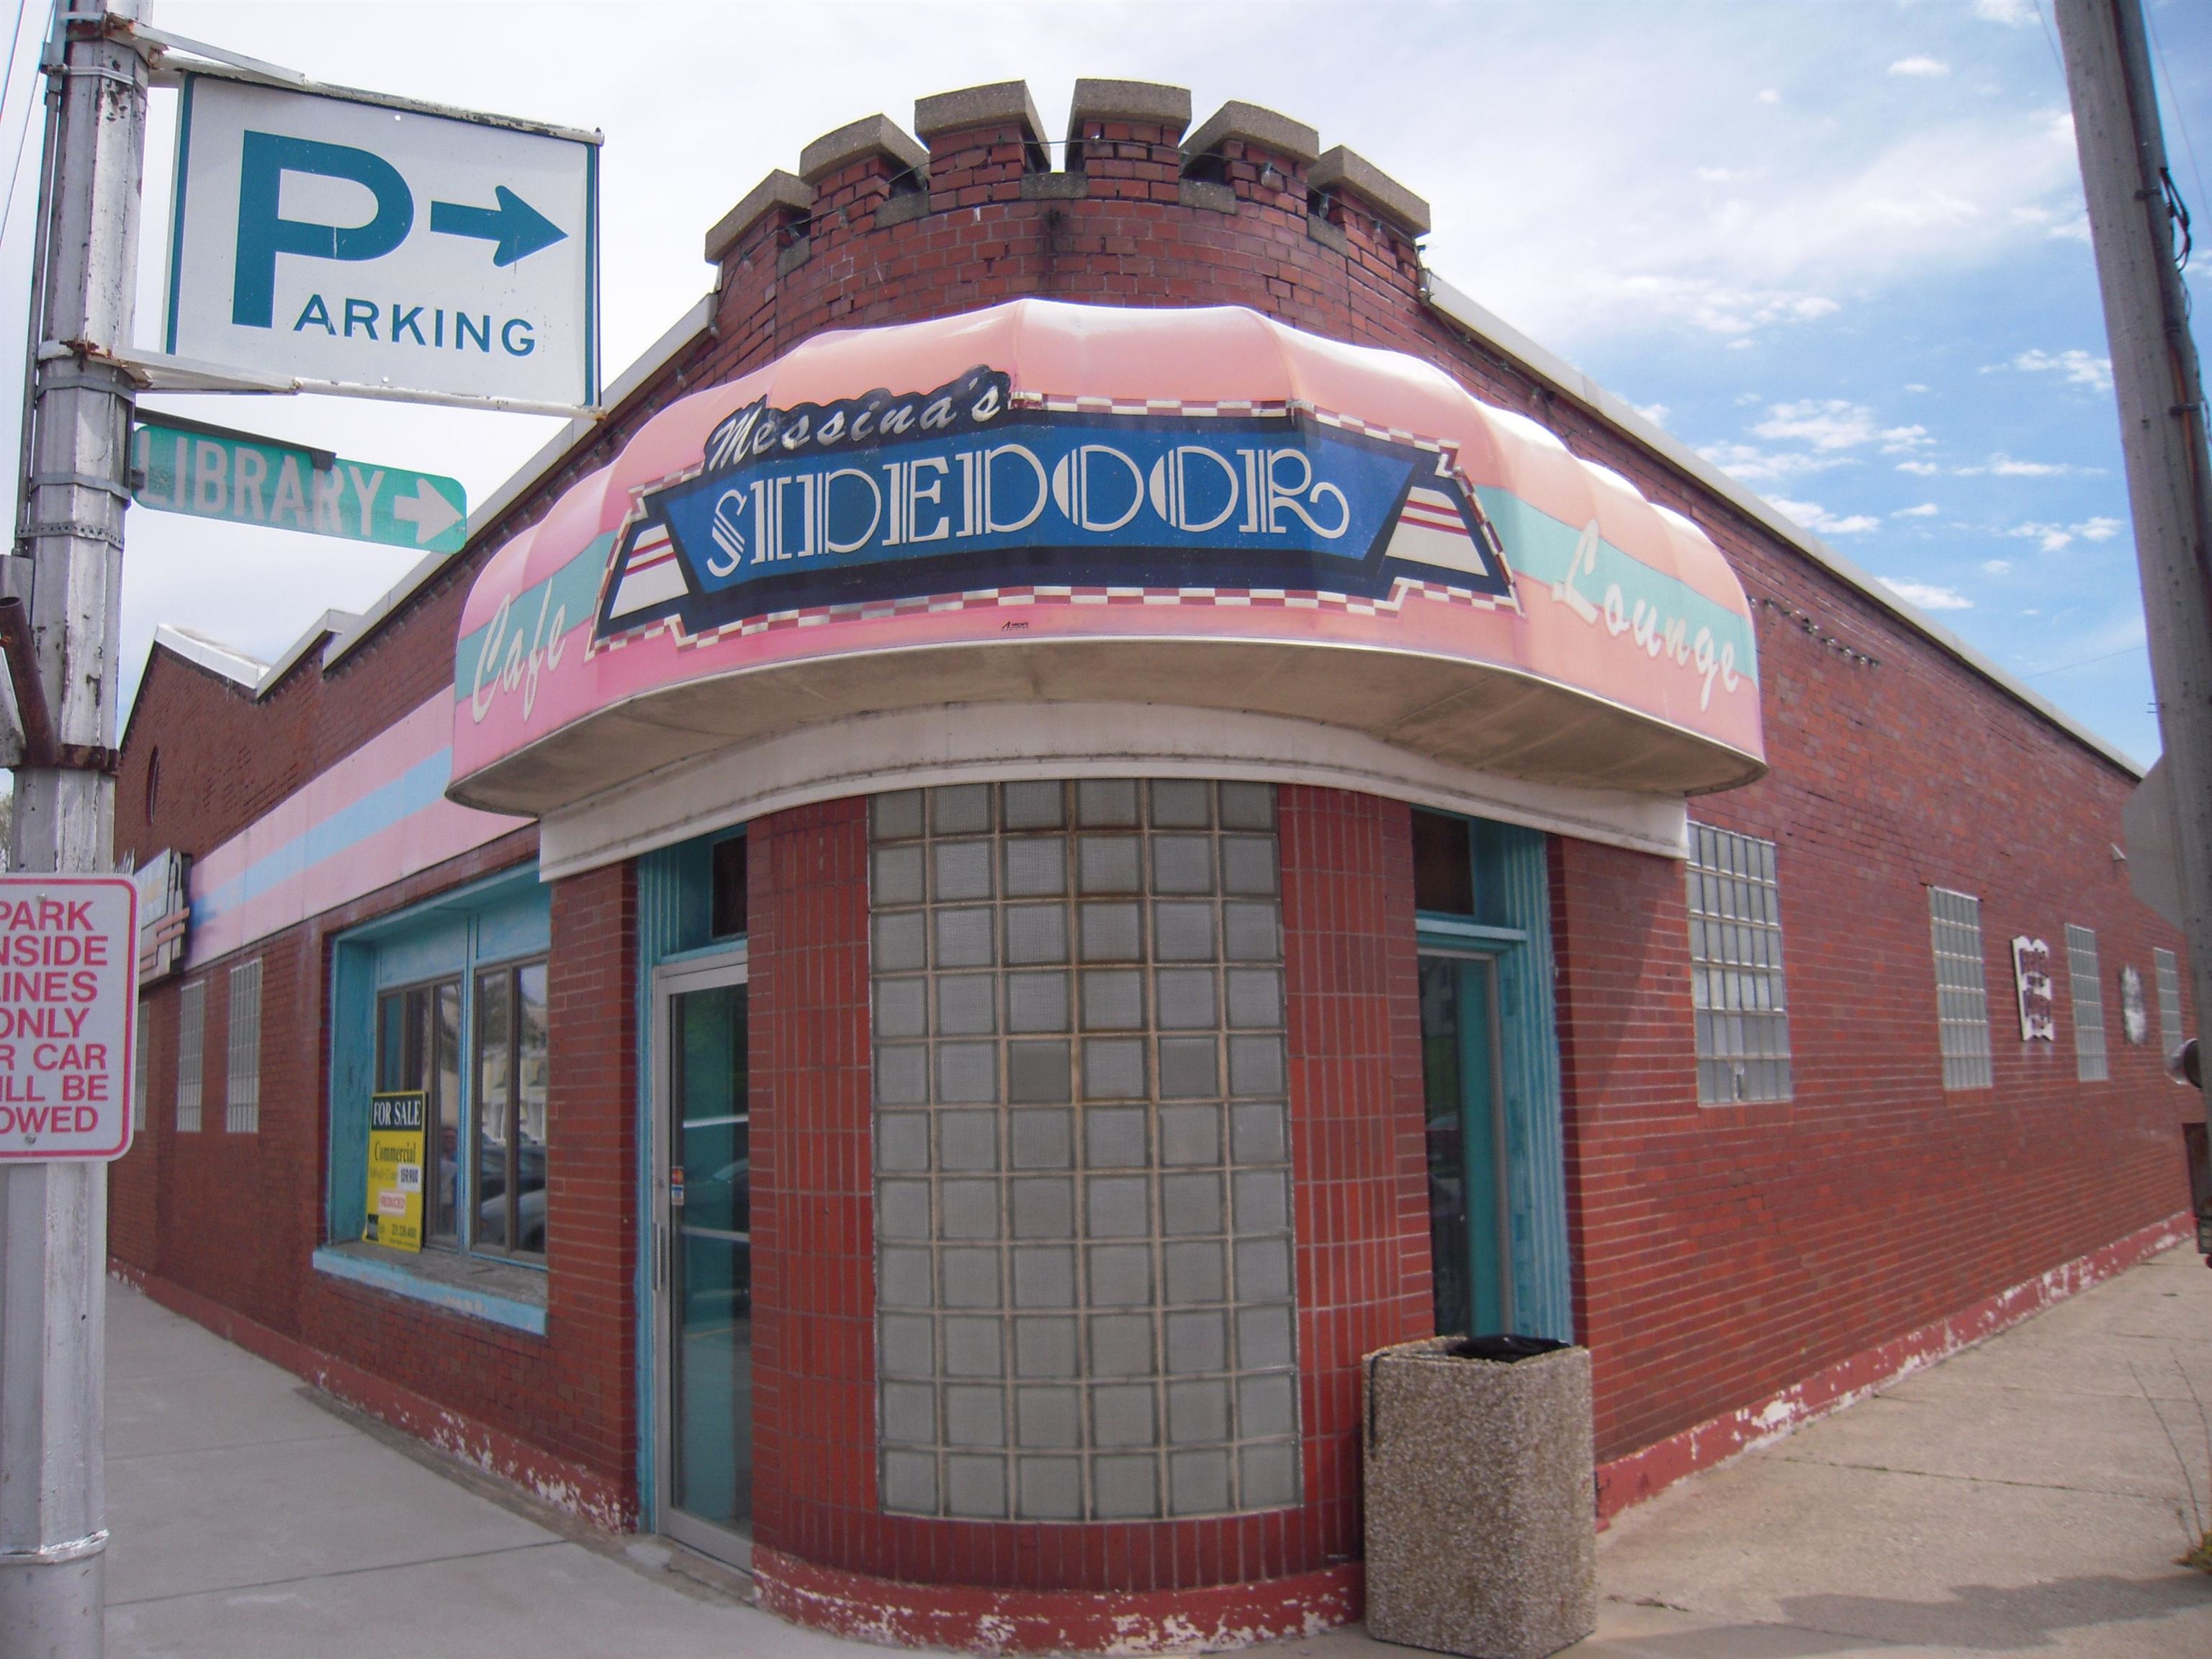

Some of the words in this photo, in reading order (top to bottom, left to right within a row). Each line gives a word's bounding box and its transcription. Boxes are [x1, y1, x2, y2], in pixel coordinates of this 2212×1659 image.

[232, 130, 536, 357] PARKING
[709, 377, 1000, 472] Messina's
[138, 431, 385, 536] LIBRARY
[706, 444, 1349, 577] SIDEDOOR
[471, 578, 567, 724] Cafe
[1551, 519, 1740, 711] Lounge
[0, 971, 98, 1002] INES
[33, 1043, 107, 1071] CAR
[62, 1074, 109, 1102] BE
[373, 1102, 392, 1125] FOR
[394, 1100, 421, 1125] SALE
[374, 1141, 416, 1163] Commercial
